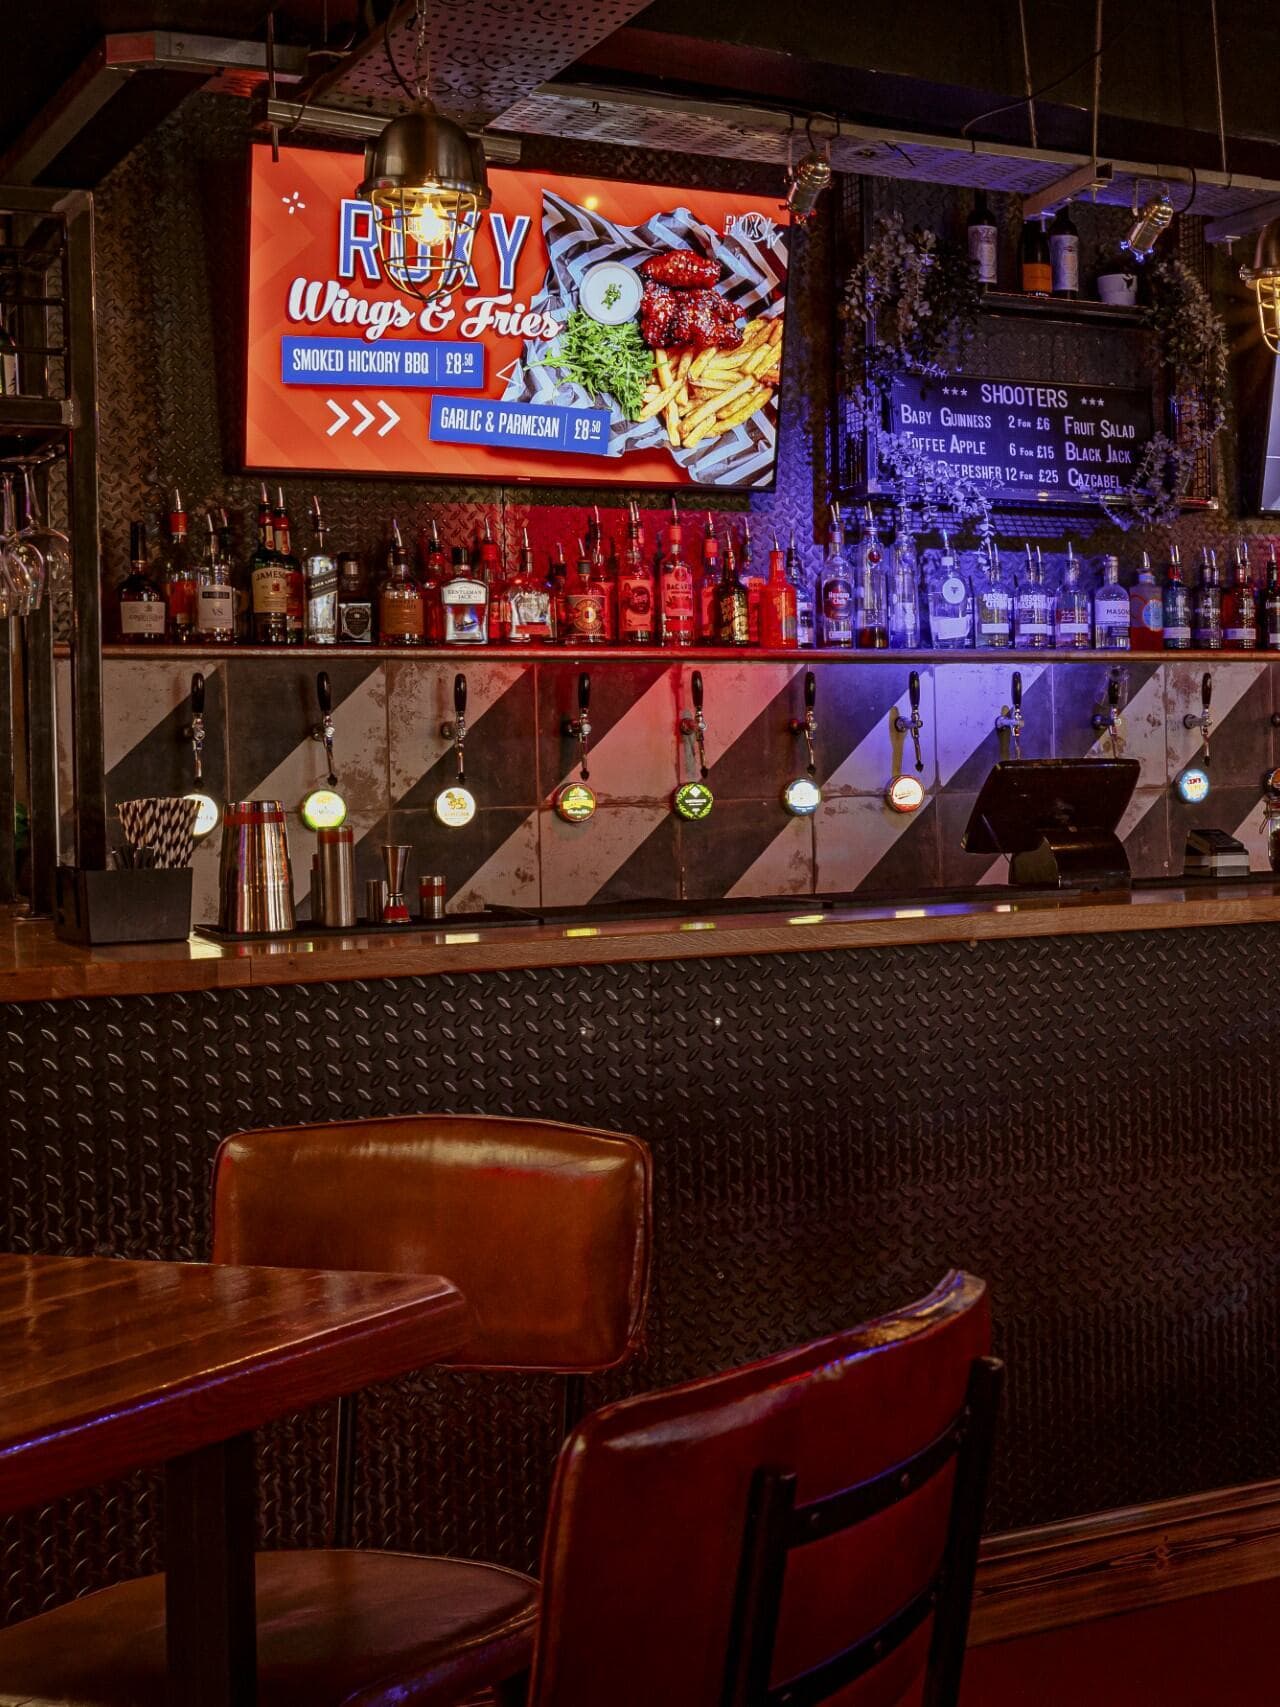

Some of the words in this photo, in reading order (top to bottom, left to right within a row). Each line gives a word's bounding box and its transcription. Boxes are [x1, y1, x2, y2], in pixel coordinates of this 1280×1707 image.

[338, 198, 531, 291] ROXY
[288, 277, 416, 341] Wings
[419, 290, 456, 333] &
[460, 293, 564, 339] Fries
[292, 348, 344, 372] SMOKED
[348, 350, 401, 374] HICKORY
[404, 351, 429, 375] BBQ
[981, 383, 1068, 409] SHOOTERS
[440, 406, 483, 432] GARLIC
[485, 410, 495, 433] &
[498, 412, 561, 439] PARMESAN
[900, 404, 932, 425] BABY
[940, 407, 992, 429] GUINNESS
[1008, 415, 1016, 429] 2
[1036, 417, 1051, 431] £6
[1064, 415, 1096, 436] FRUIT
[1100, 419, 1136, 439] SALAD
[950, 434, 987, 455] APPLE
[1009, 443, 1016, 457] 6
[1036, 445, 1055, 460] £15
[1065, 441, 1102, 462] BLACK
[1106, 444, 1132, 464] JACK
[937, 460, 1002, 480] RRESHER
[1005, 467, 1018, 481] 12
[1038, 469, 1059, 484] £25
[1067, 467, 1122, 489] CAZCABEL
[255, 570, 287, 581] JAMES
